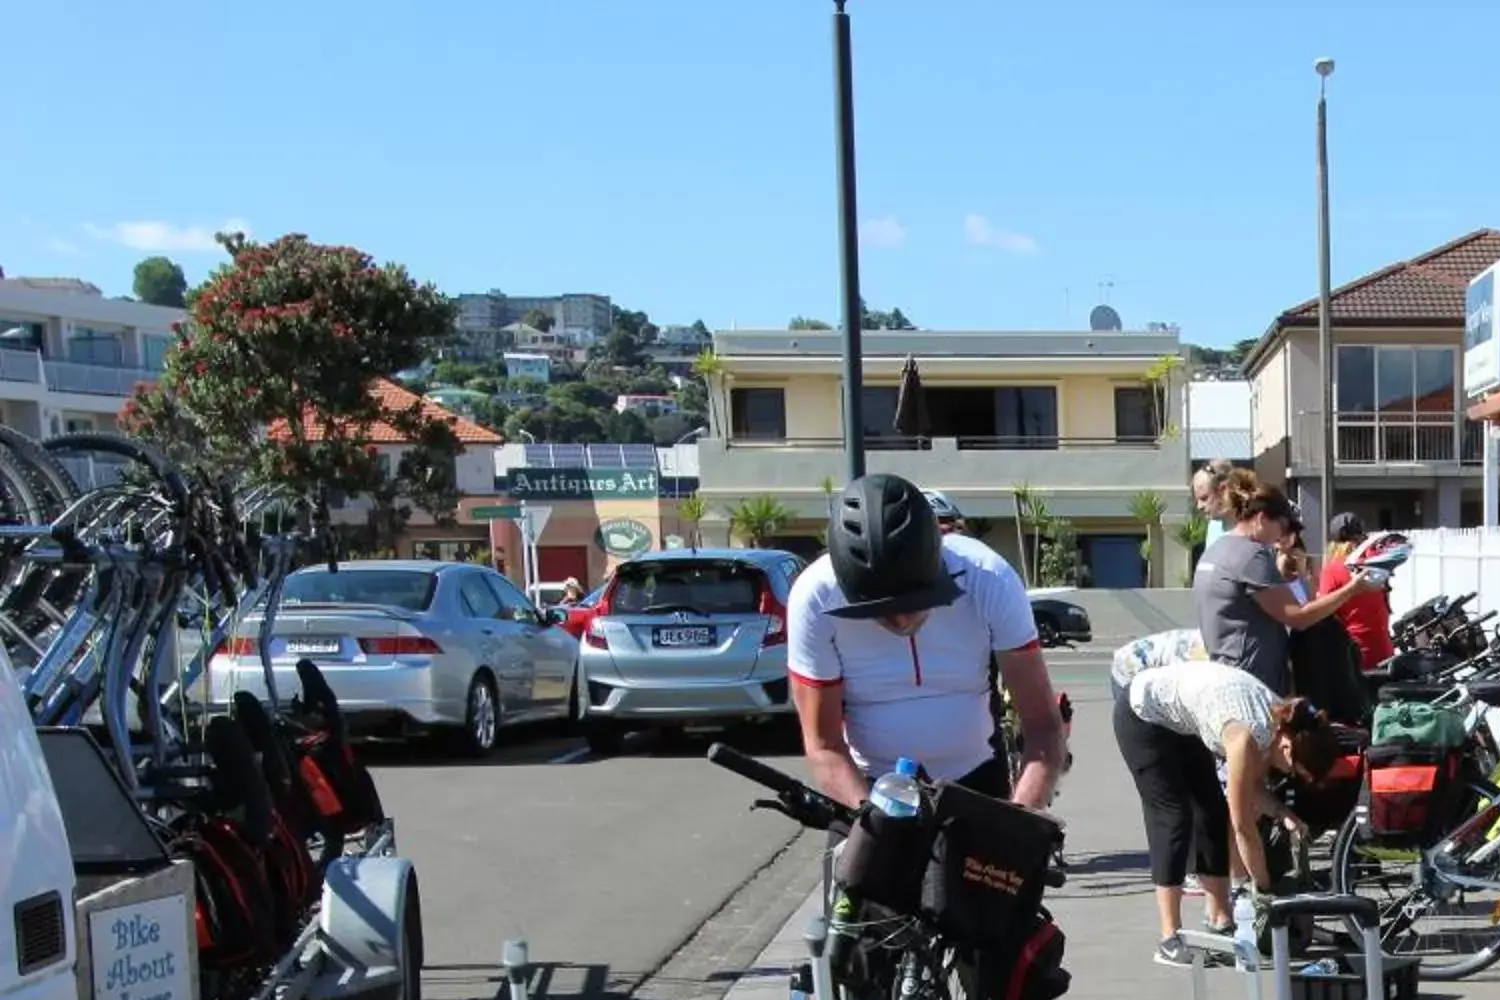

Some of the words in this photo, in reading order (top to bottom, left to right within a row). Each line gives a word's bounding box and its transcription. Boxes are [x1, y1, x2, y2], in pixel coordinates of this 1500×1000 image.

[512, 473, 616, 494] Antiques
[617, 472, 656, 493] Art
[112, 914, 160, 950] Bike
[106, 952, 175, 990] About
